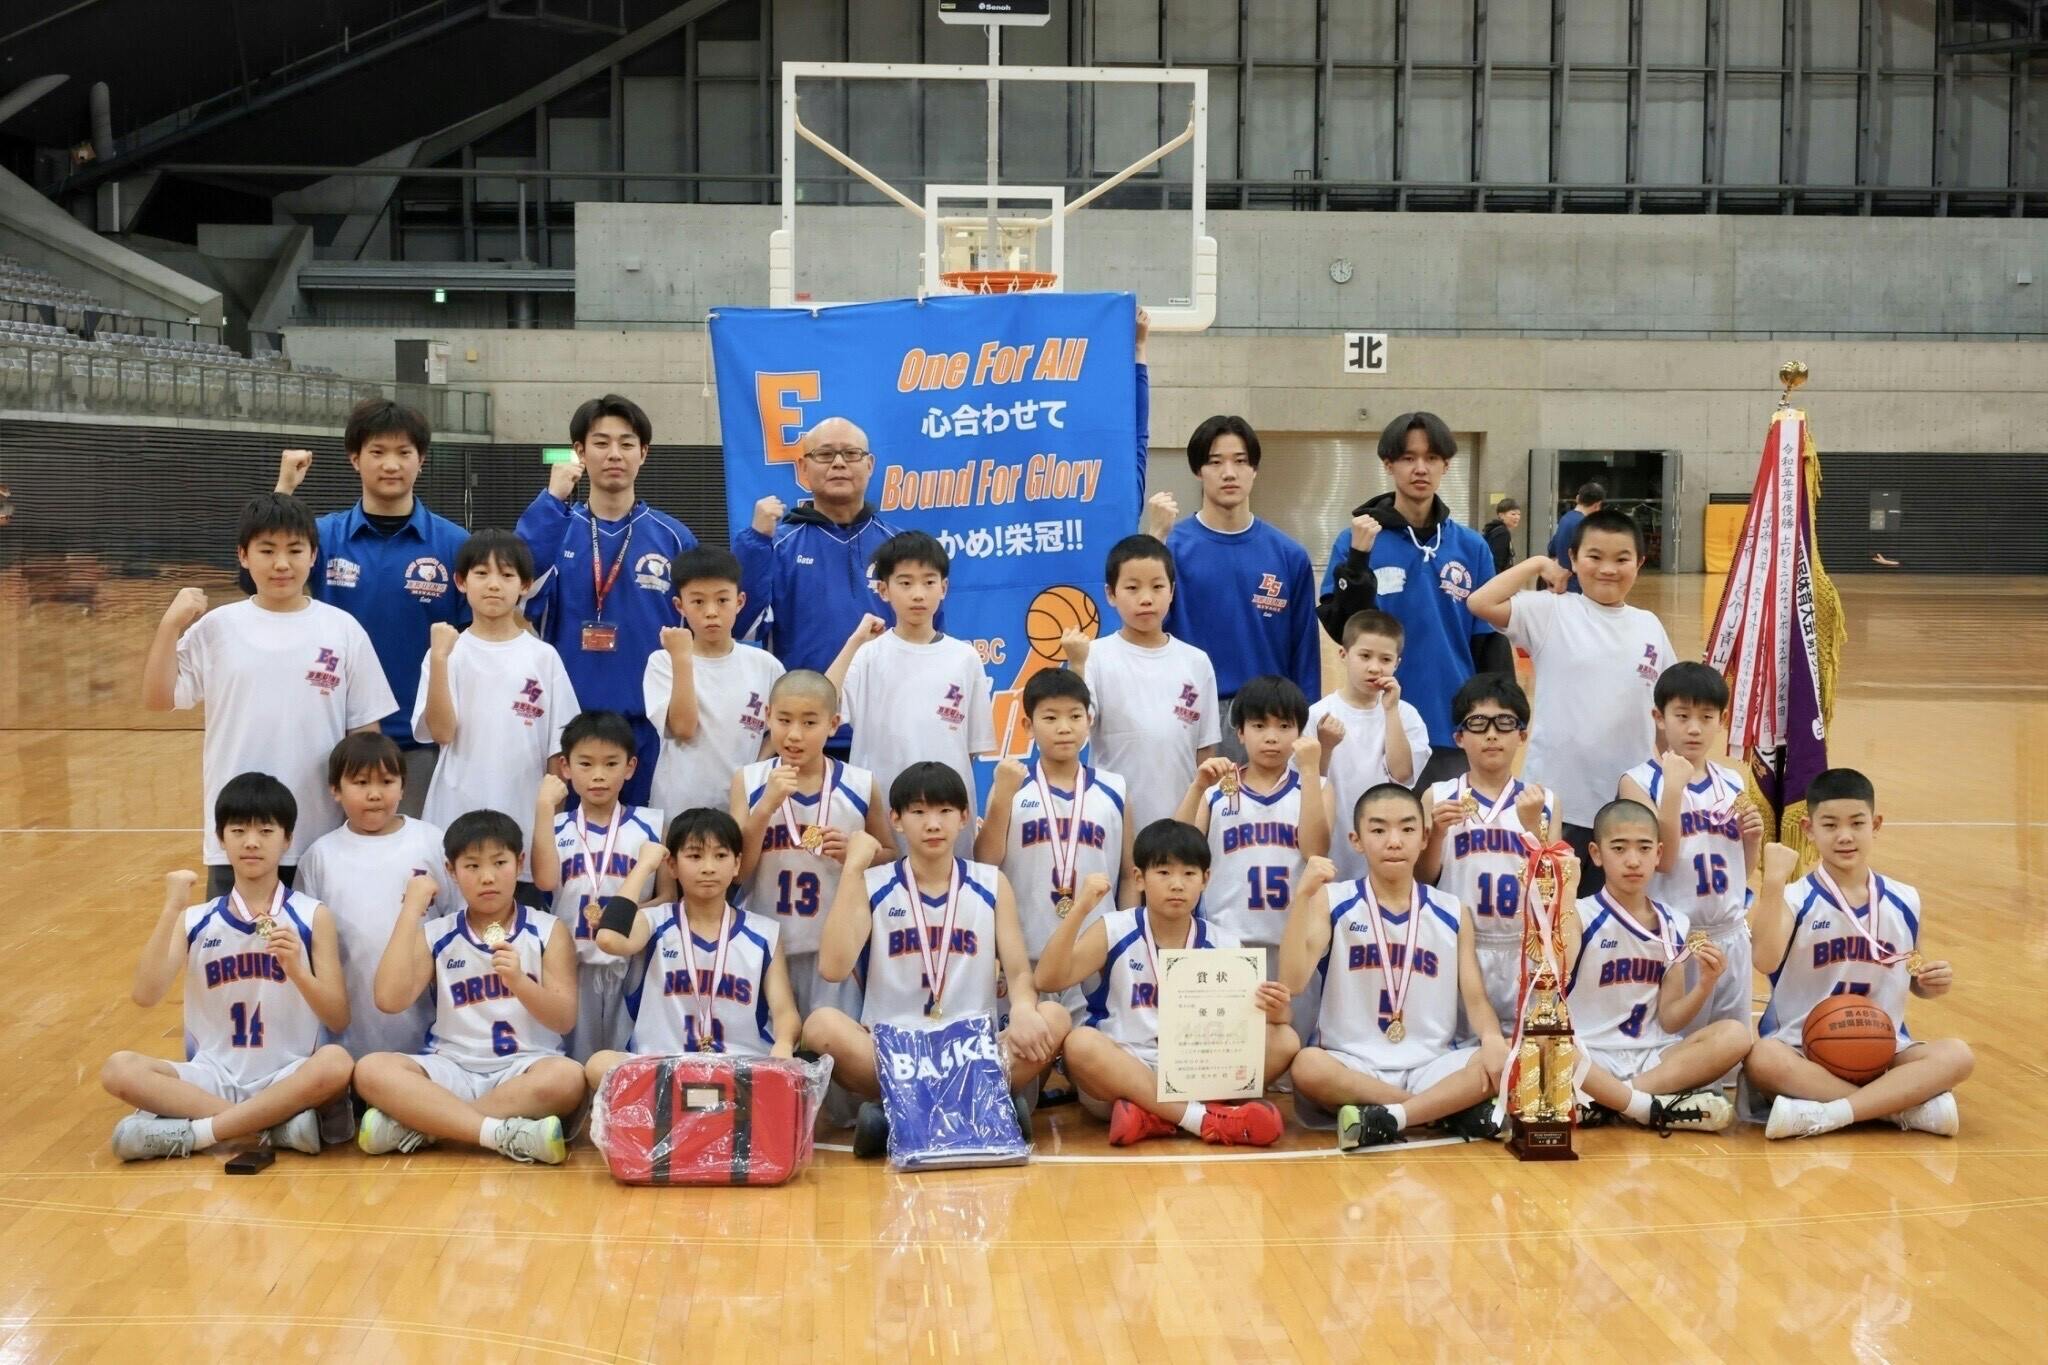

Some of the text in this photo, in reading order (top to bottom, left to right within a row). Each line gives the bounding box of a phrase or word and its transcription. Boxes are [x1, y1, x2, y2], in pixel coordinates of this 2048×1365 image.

[897, 337, 1089, 393] One For All
[1350, 336, 1383, 369] 北
[921, 400, 1068, 439] 心合わせて
[880, 454, 1103, 512] Bound For Glory
[797, 554, 814, 565] Gate
[1259, 573, 1283, 597] ES
[972, 638, 1006, 665] BC
[1020, 799, 1040, 809] Gate
[1454, 829, 1532, 860] BRUIN
[1248, 867, 1290, 910] 15
[1694, 853, 1729, 897] 16
[776, 870, 820, 917] 13
[1477, 873, 1520, 918] 18
[888, 907, 907, 917] Gate
[1350, 921, 1369, 933] Gate
[1812, 920, 1831, 930] Gate
[1600, 938, 1618, 949] Gate
[447, 959, 466, 970] Gate
[1197, 971, 1228, 984] 賞状
[1599, 958, 1666, 988] BRUIN
[230, 1000, 264, 1049] 14
[491, 1021, 519, 1058] 6
